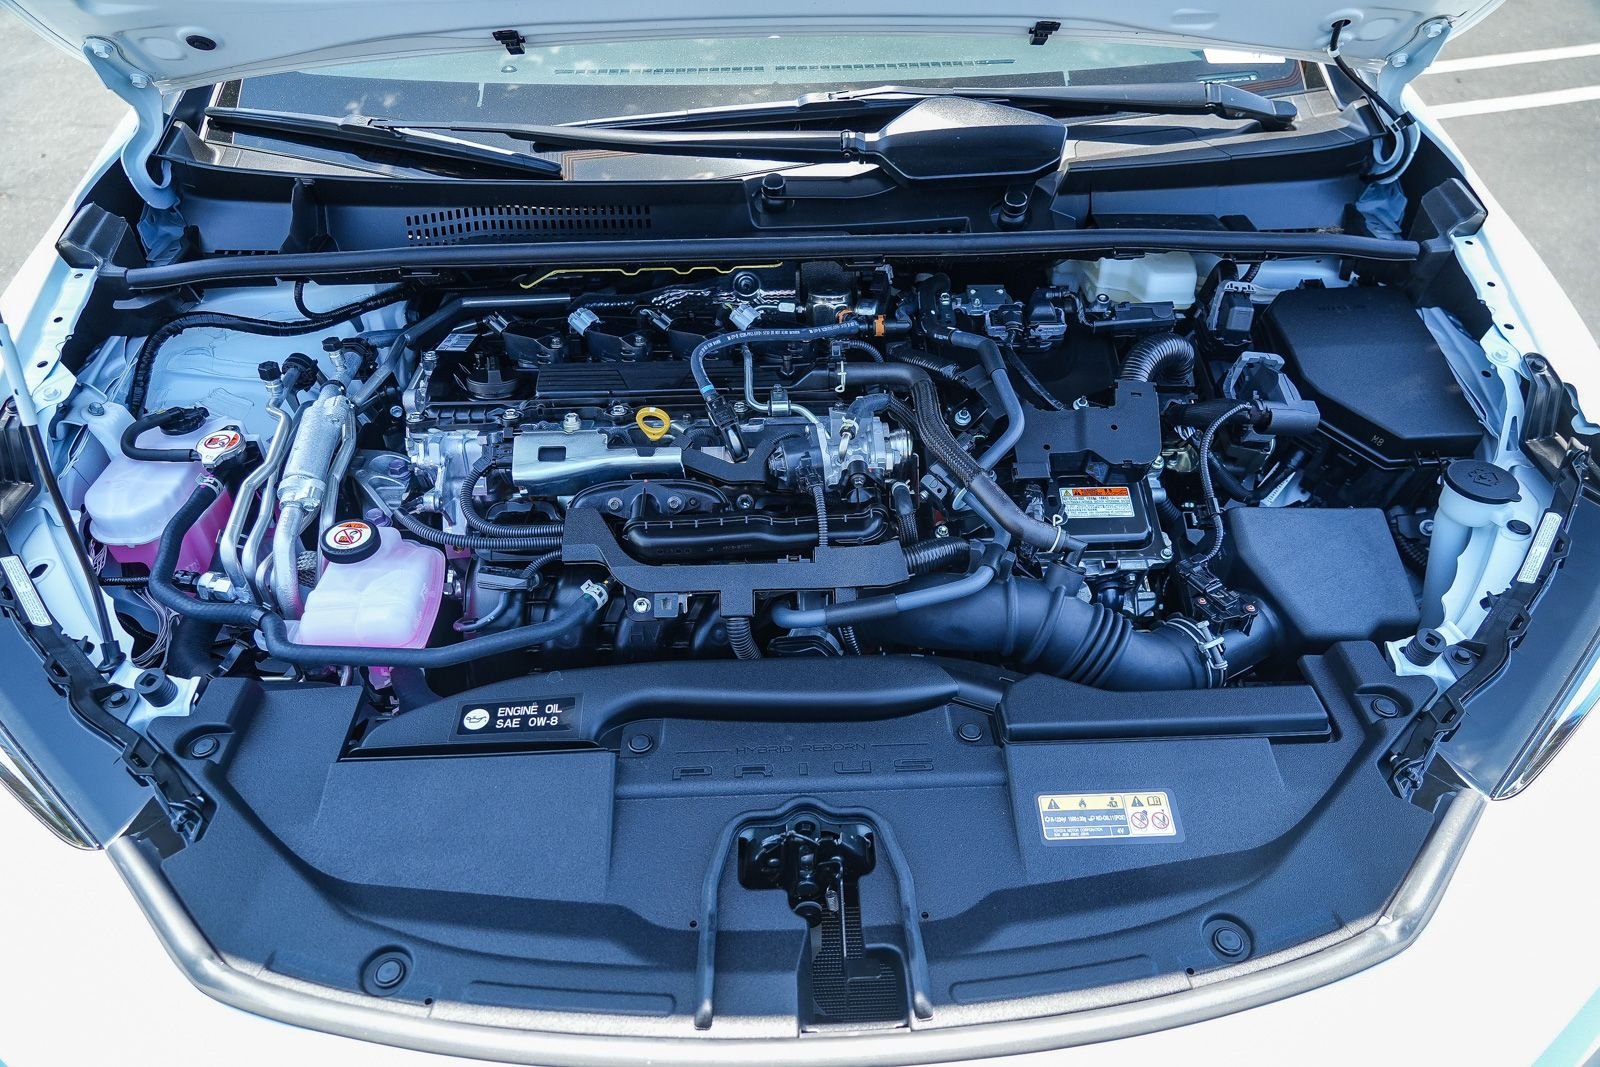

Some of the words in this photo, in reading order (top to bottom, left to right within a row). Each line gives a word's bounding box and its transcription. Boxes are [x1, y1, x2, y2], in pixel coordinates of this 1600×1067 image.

[497, 705, 538, 717] ENGINE
[545, 704, 562, 714] OIL
[495, 718, 521, 728] SAE
[528, 716, 558, 727] 0W-8
[736, 745, 793, 755] HYBRID
[801, 743, 866, 752] REBORN
[672, 758, 934, 780] PRIUS
